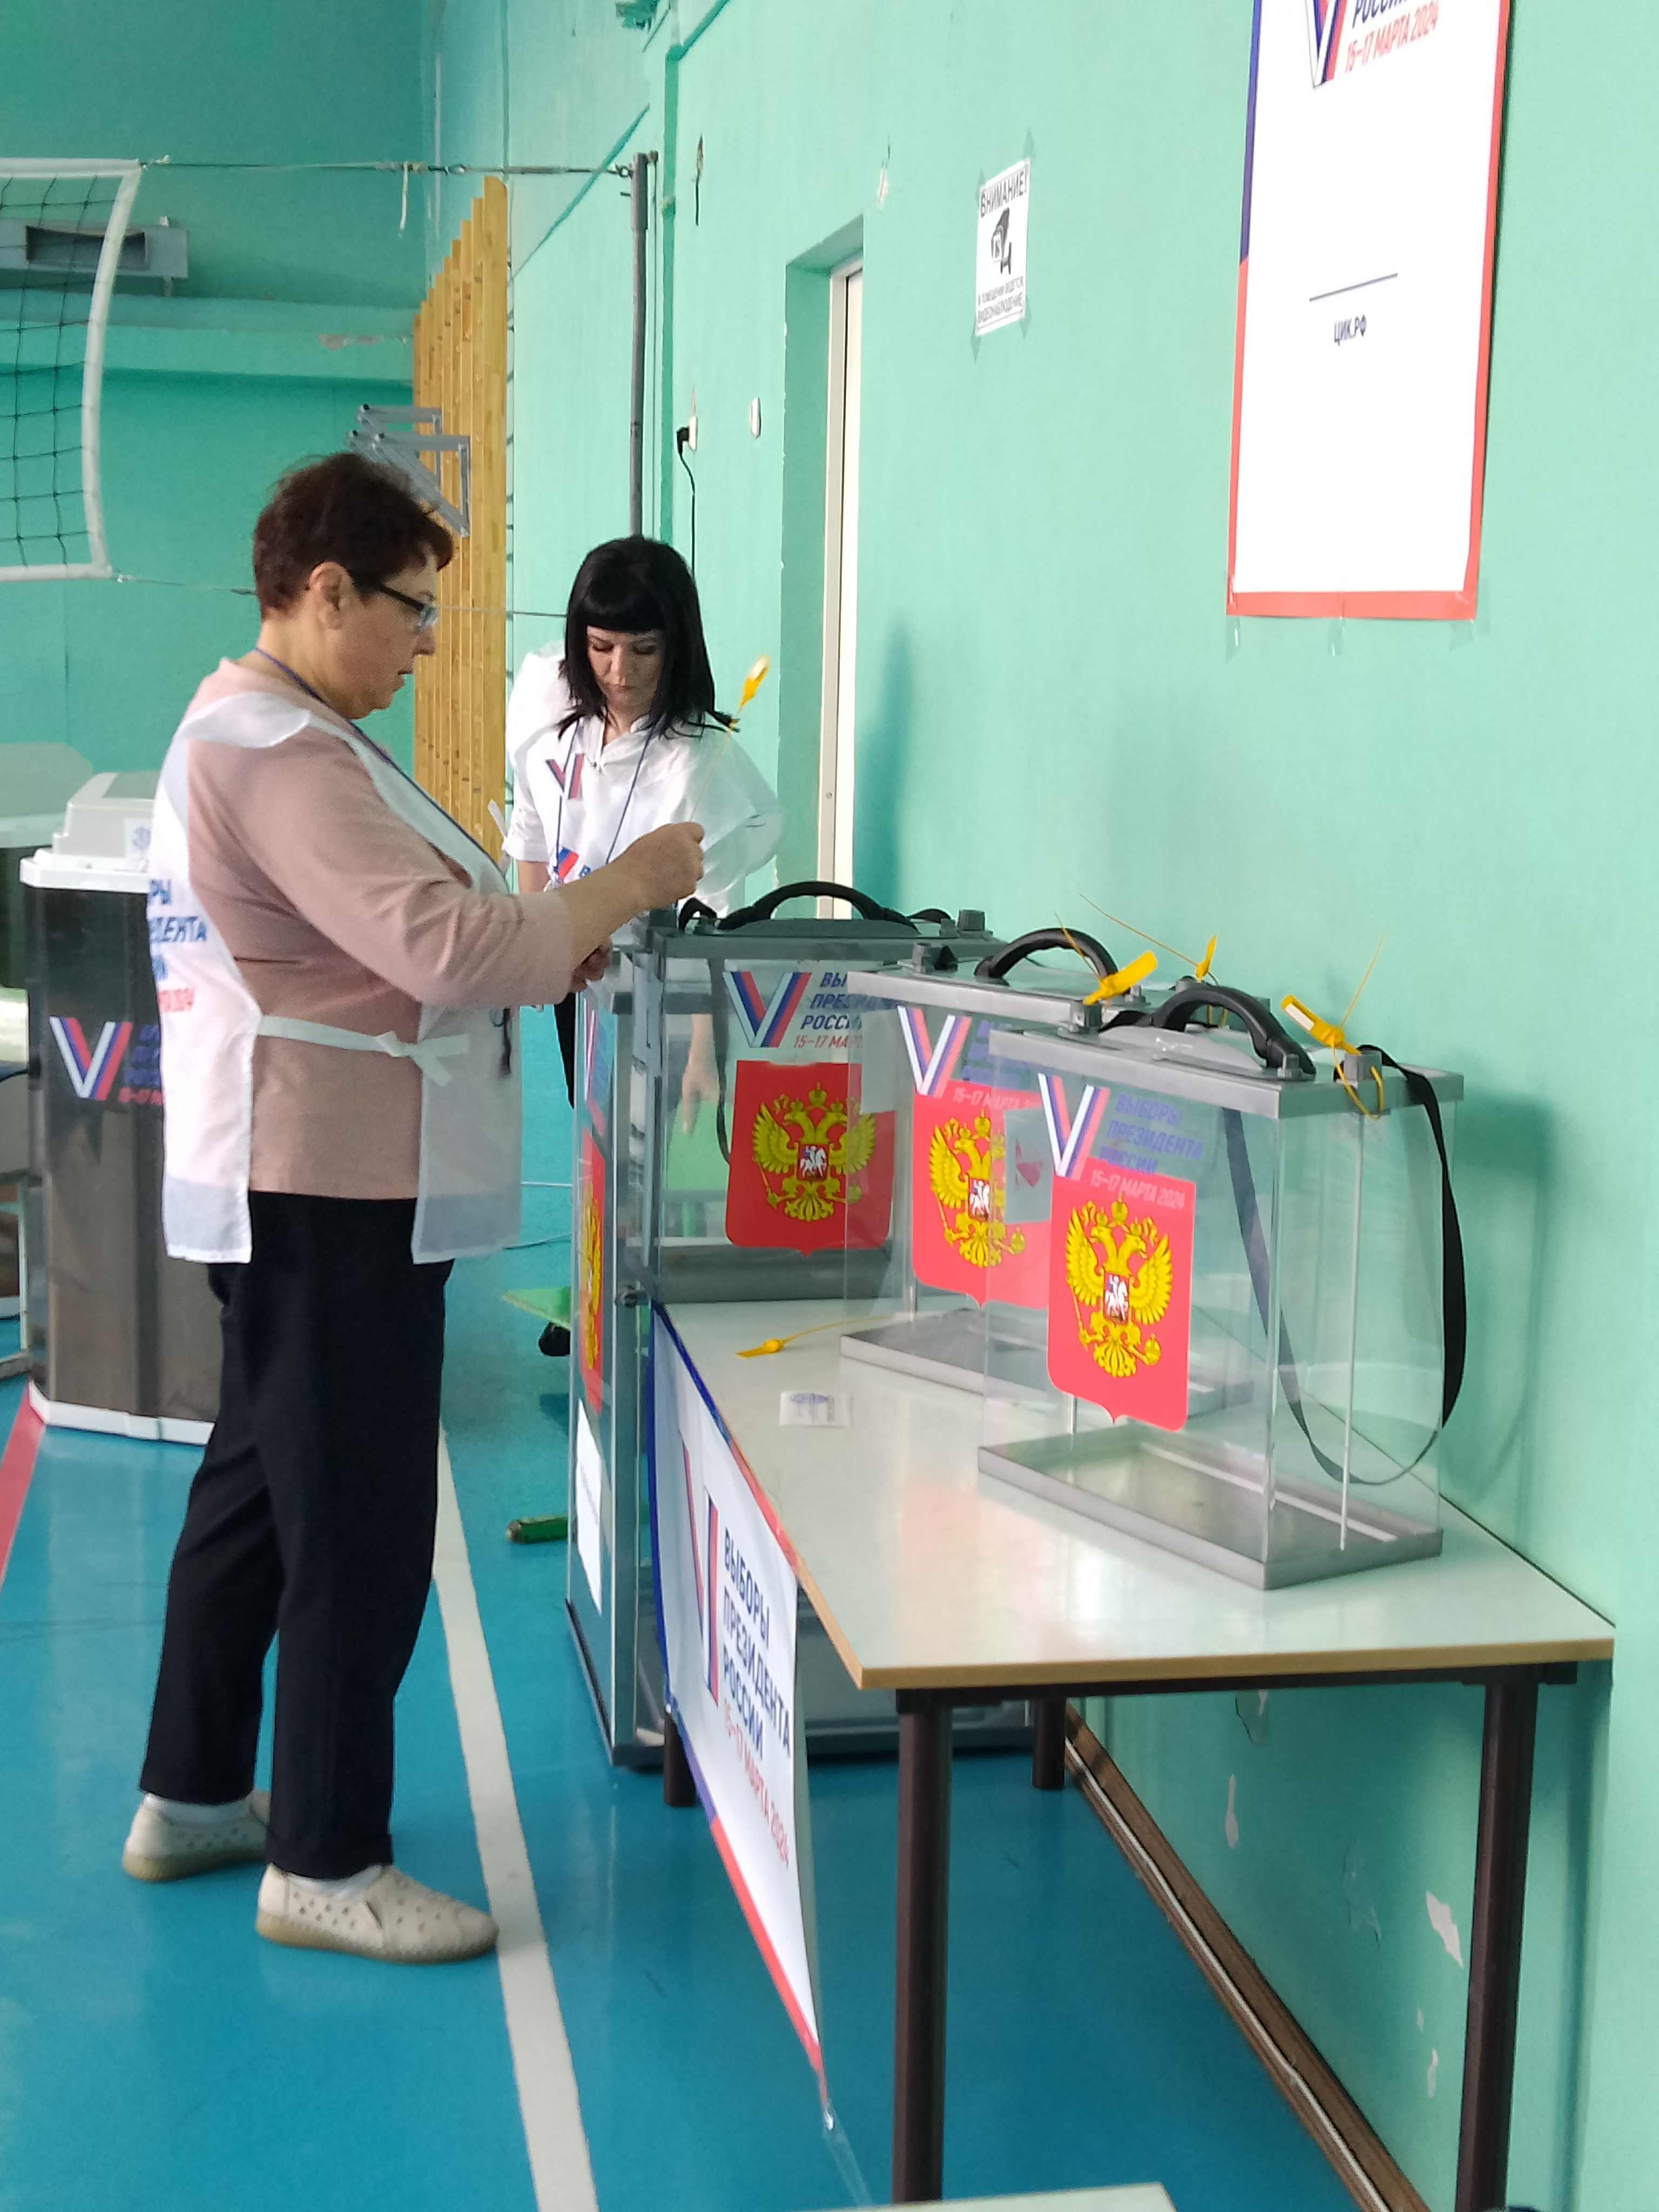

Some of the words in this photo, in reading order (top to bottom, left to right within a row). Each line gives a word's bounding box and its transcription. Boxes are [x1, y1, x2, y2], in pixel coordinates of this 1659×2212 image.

[1334, 313, 1367, 346] ЦИК.РФ
[1116, 1094, 1182, 1125] ВЫБОРЫ
[1108, 1120, 1202, 1158] ПРЕЗИДЕНТА
[1091, 1170, 1121, 1191] 15-17
[1120, 1178, 1157, 1202] МАРТА
[724, 1526, 770, 1650] ВЫБОРЫ
[724, 1584, 791, 1759] ПРЕЗИДЕНТА
[724, 1643, 763, 1761] РОССИИ
